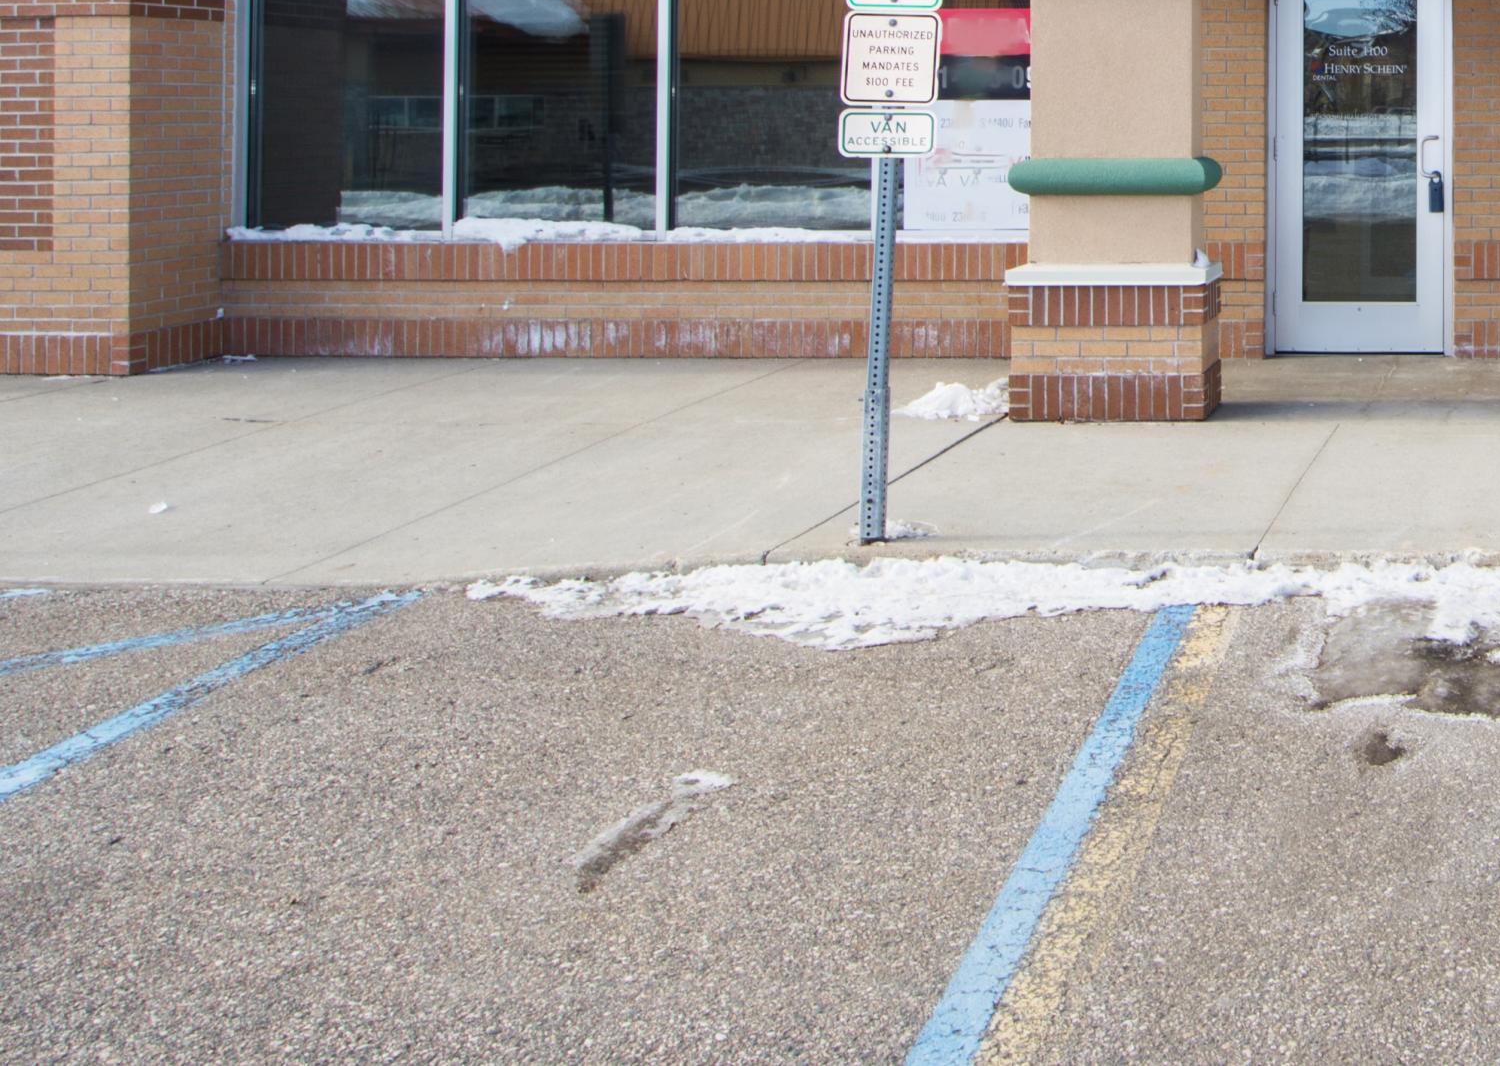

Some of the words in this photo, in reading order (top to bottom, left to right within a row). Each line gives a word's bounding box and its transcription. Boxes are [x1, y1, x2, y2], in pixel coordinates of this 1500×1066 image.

[852, 29, 934, 41] UNAUTHORIZED
[869, 45, 915, 56] PARKING
[1328, 45, 1358, 57] Suite
[862, 60, 920, 72] MANDATES
[1324, 63, 1362, 74] HENRY
[865, 76, 889, 87] $100
[896, 77, 915, 87] FEE
[870, 120, 907, 134] VAN
[847, 136, 927, 147] ACCESSIBLE
